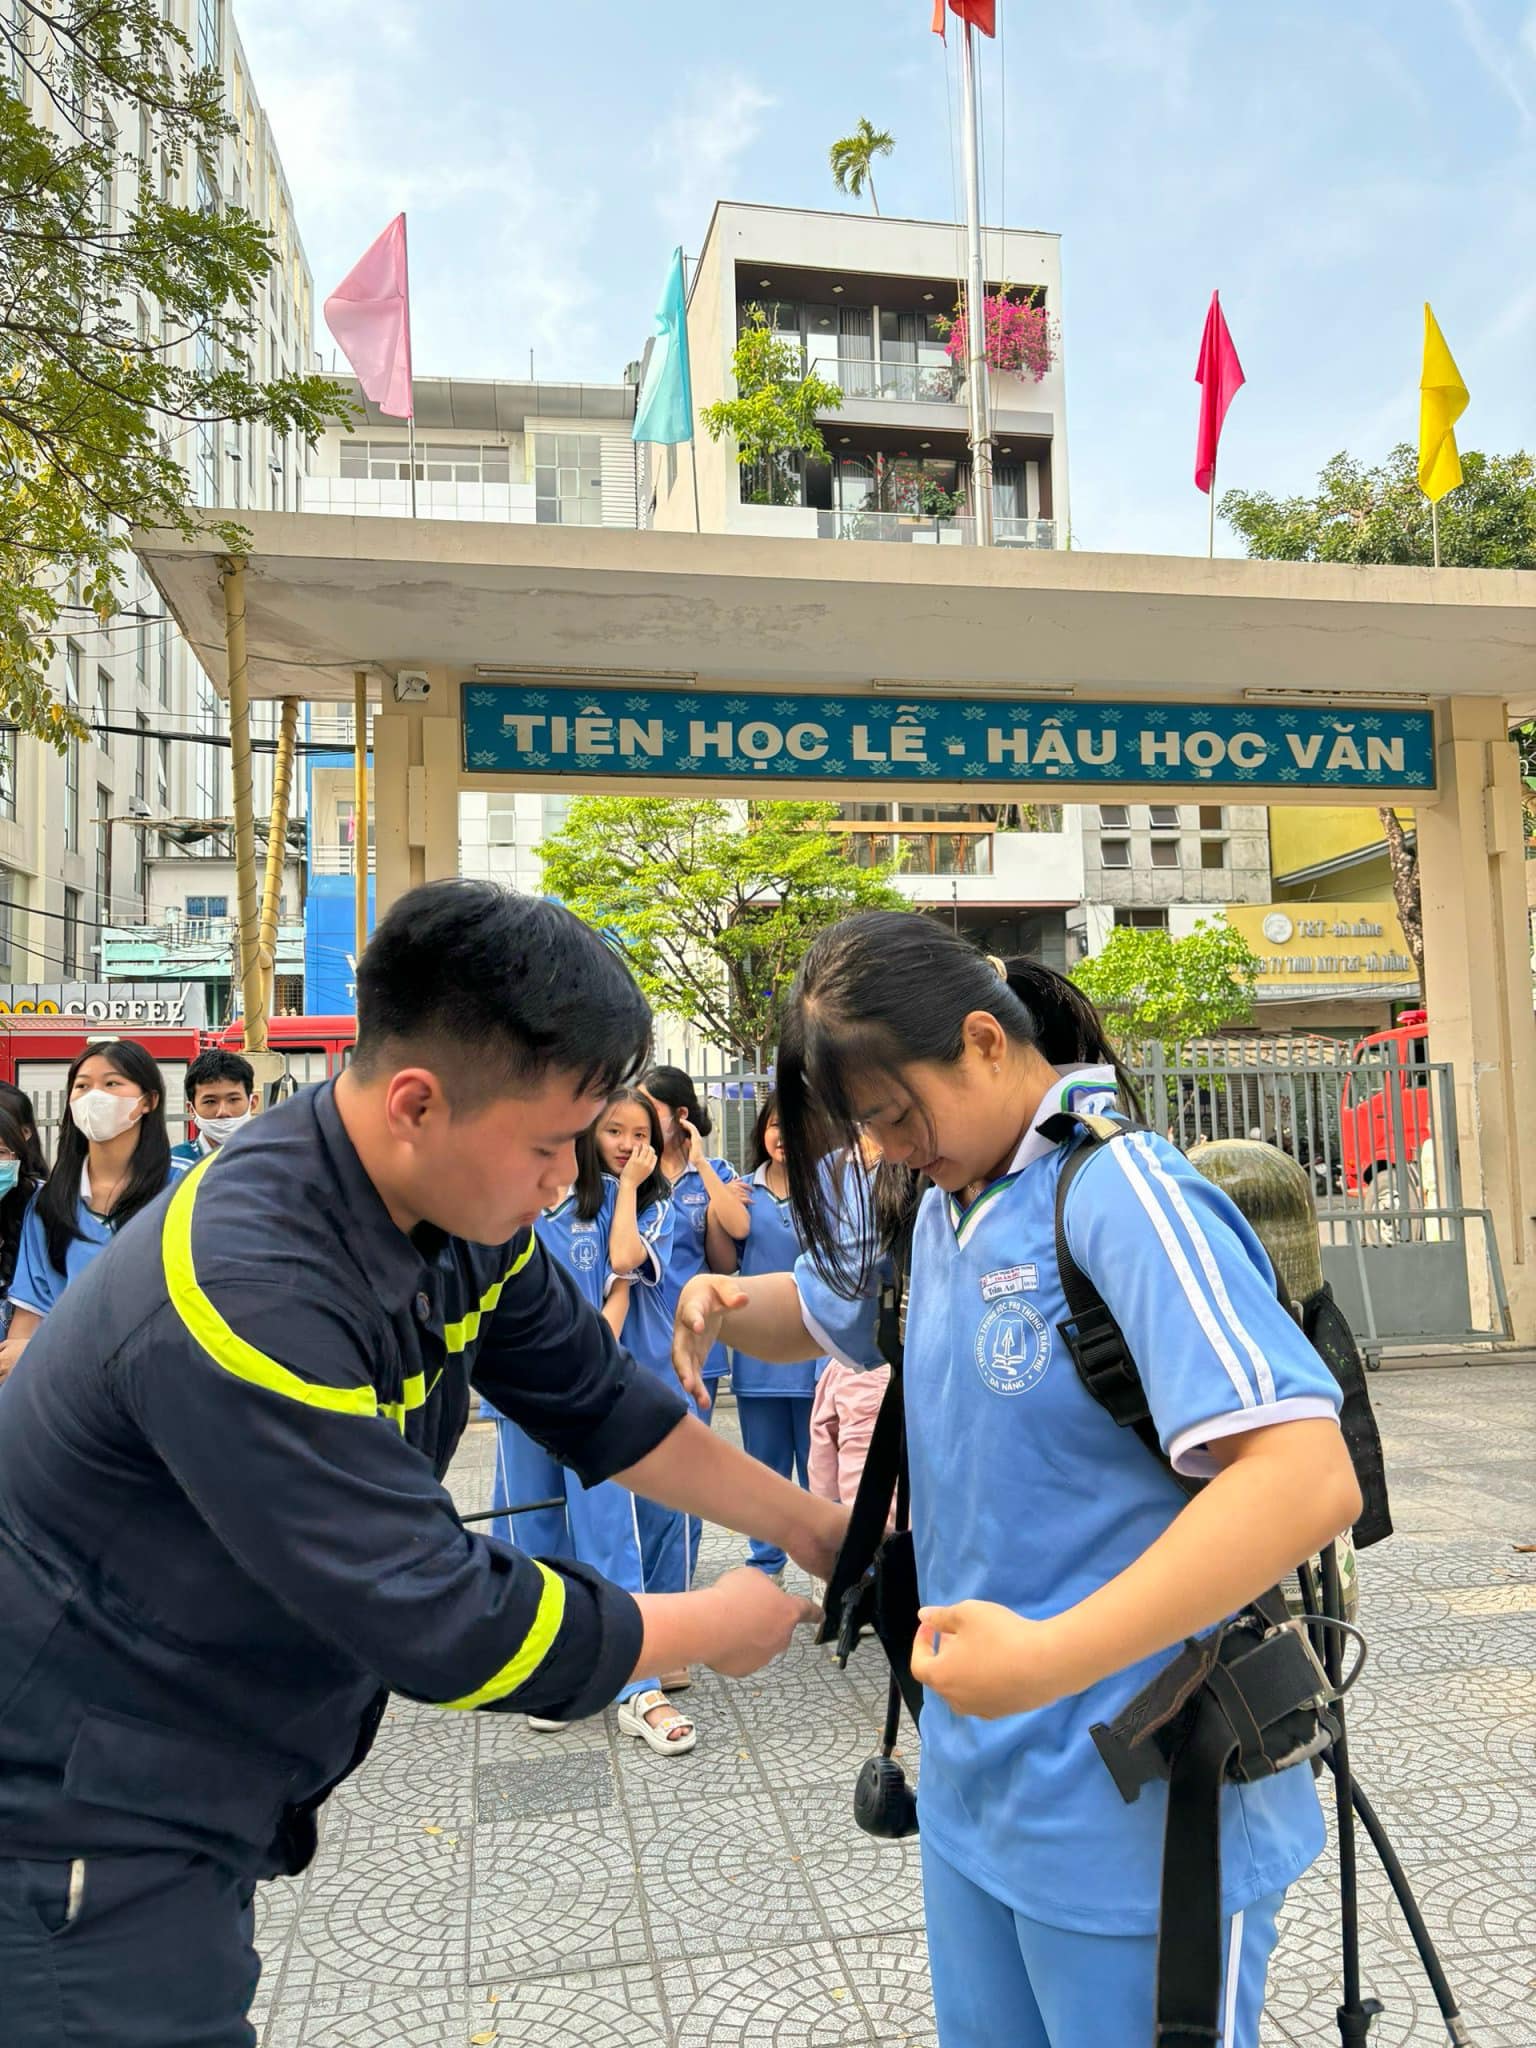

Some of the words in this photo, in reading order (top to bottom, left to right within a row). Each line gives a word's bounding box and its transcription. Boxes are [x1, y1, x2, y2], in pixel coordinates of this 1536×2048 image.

[504, 706, 664, 757] TIÊN
[690, 721, 829, 770] HỌC
[852, 705, 927, 762] LỄ
[987, 718, 1117, 775] HẬU
[1140, 731, 1267, 777] HỌC
[1285, 723, 1405, 771] VĂN
[0, 1000, 60, 1014] CO
